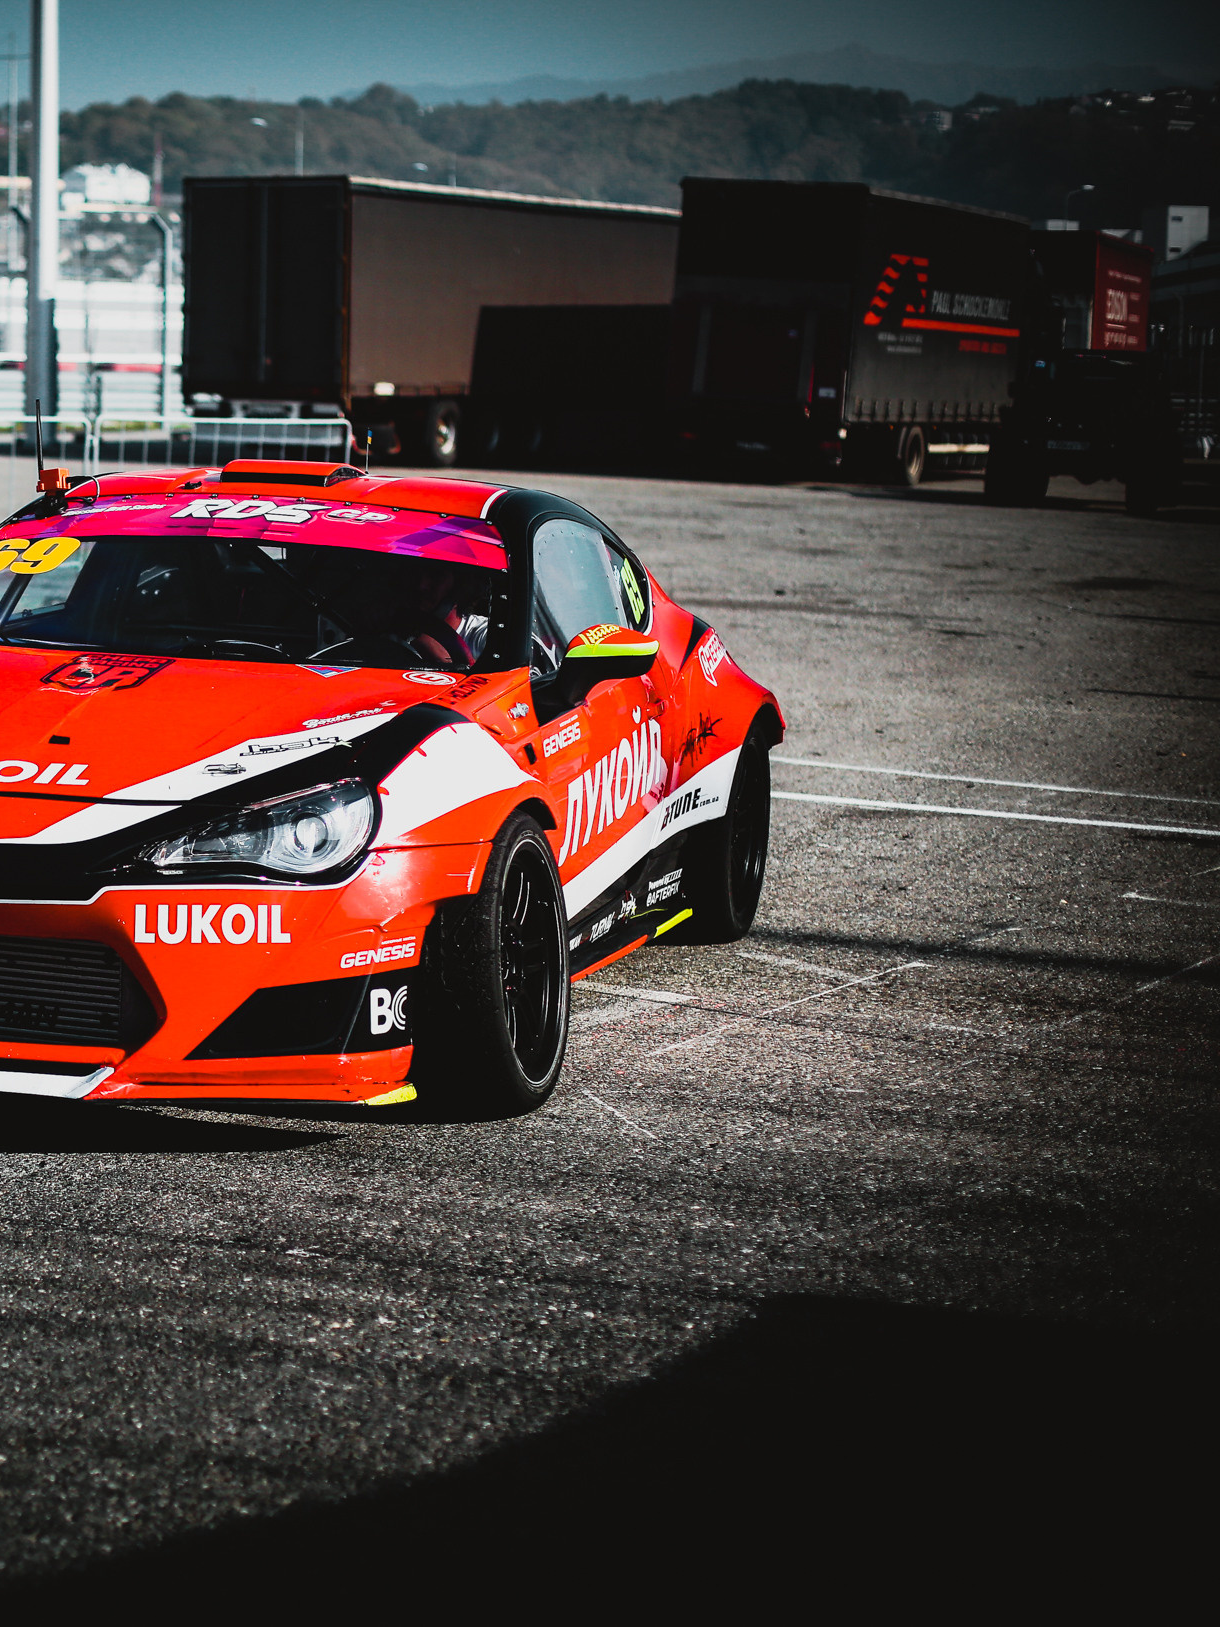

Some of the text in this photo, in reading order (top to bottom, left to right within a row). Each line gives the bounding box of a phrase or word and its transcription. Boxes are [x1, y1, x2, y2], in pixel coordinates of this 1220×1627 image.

[169, 498, 332, 524] RDS
[543, 722, 582, 758] GENESIS
[558, 705, 662, 867] ЛУКОЙЛ
[134, 904, 291, 945] LUKOIL
[340, 942, 416, 969] GENESIS
